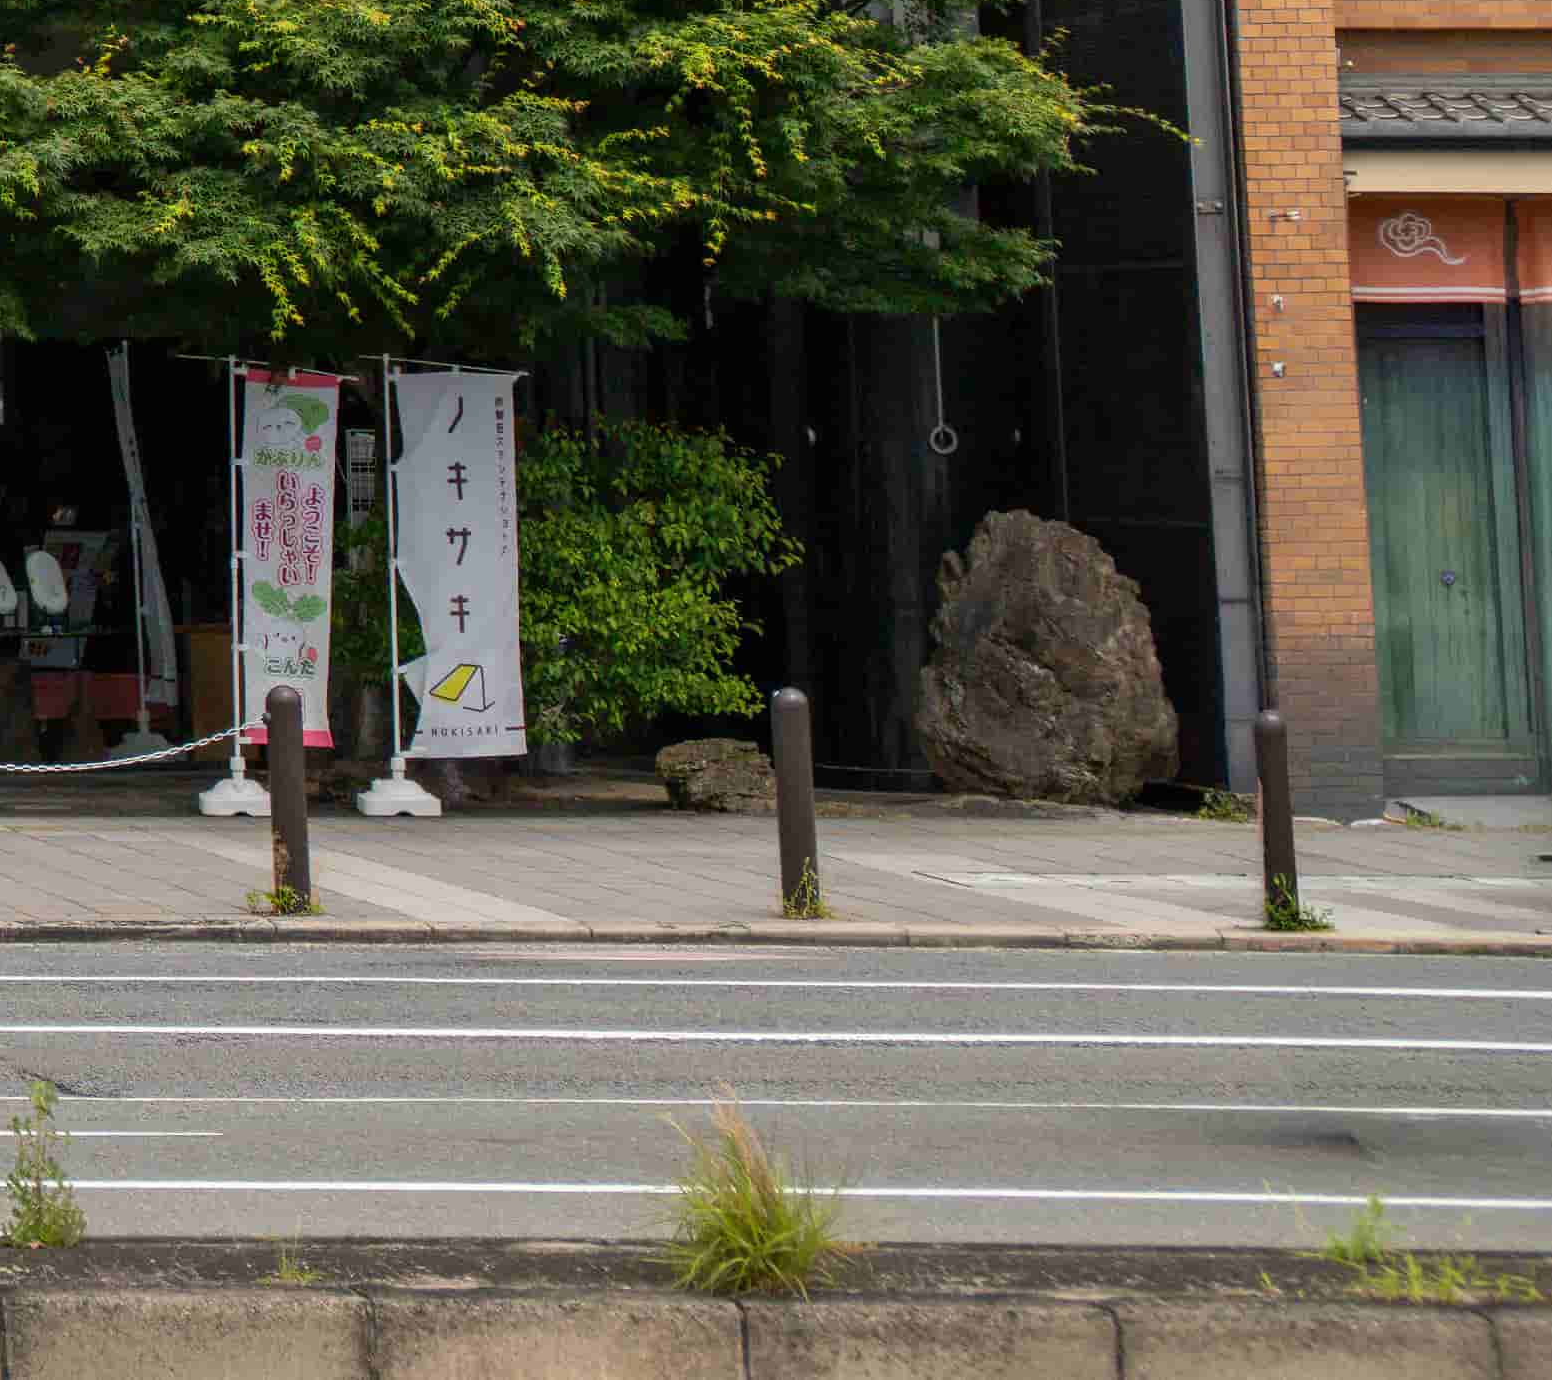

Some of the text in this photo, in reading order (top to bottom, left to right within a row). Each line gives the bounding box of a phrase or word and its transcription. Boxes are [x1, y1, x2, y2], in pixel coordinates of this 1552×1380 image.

[446, 396, 472, 633] ノキサキ
[431, 726, 500, 738] NOKISAKI
